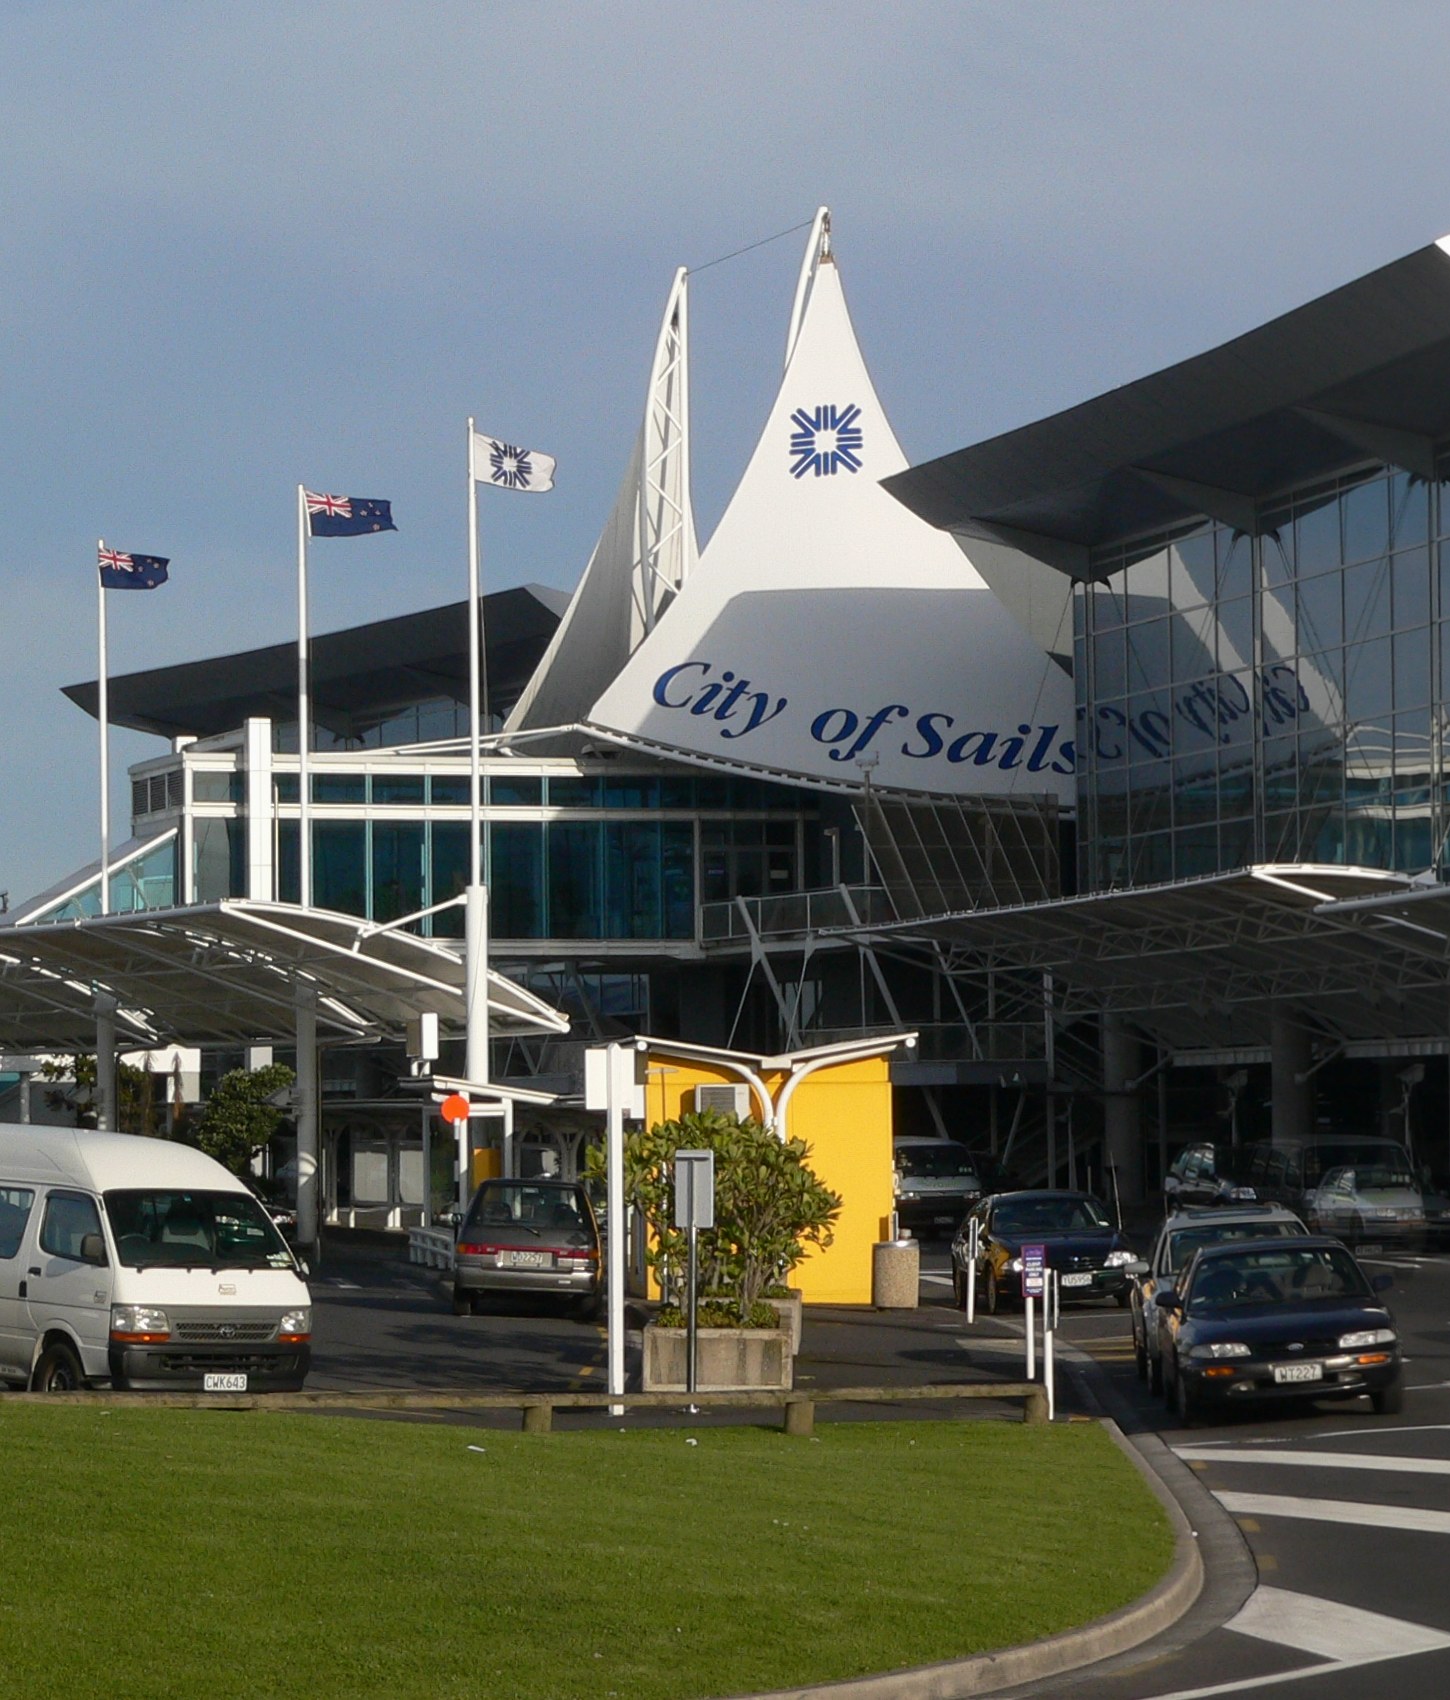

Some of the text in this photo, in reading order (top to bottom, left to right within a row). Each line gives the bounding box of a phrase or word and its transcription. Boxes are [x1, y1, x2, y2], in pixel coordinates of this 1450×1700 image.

[652, 661, 1076, 775] City of Sails
[205, 1375, 247, 1390] CWK643
